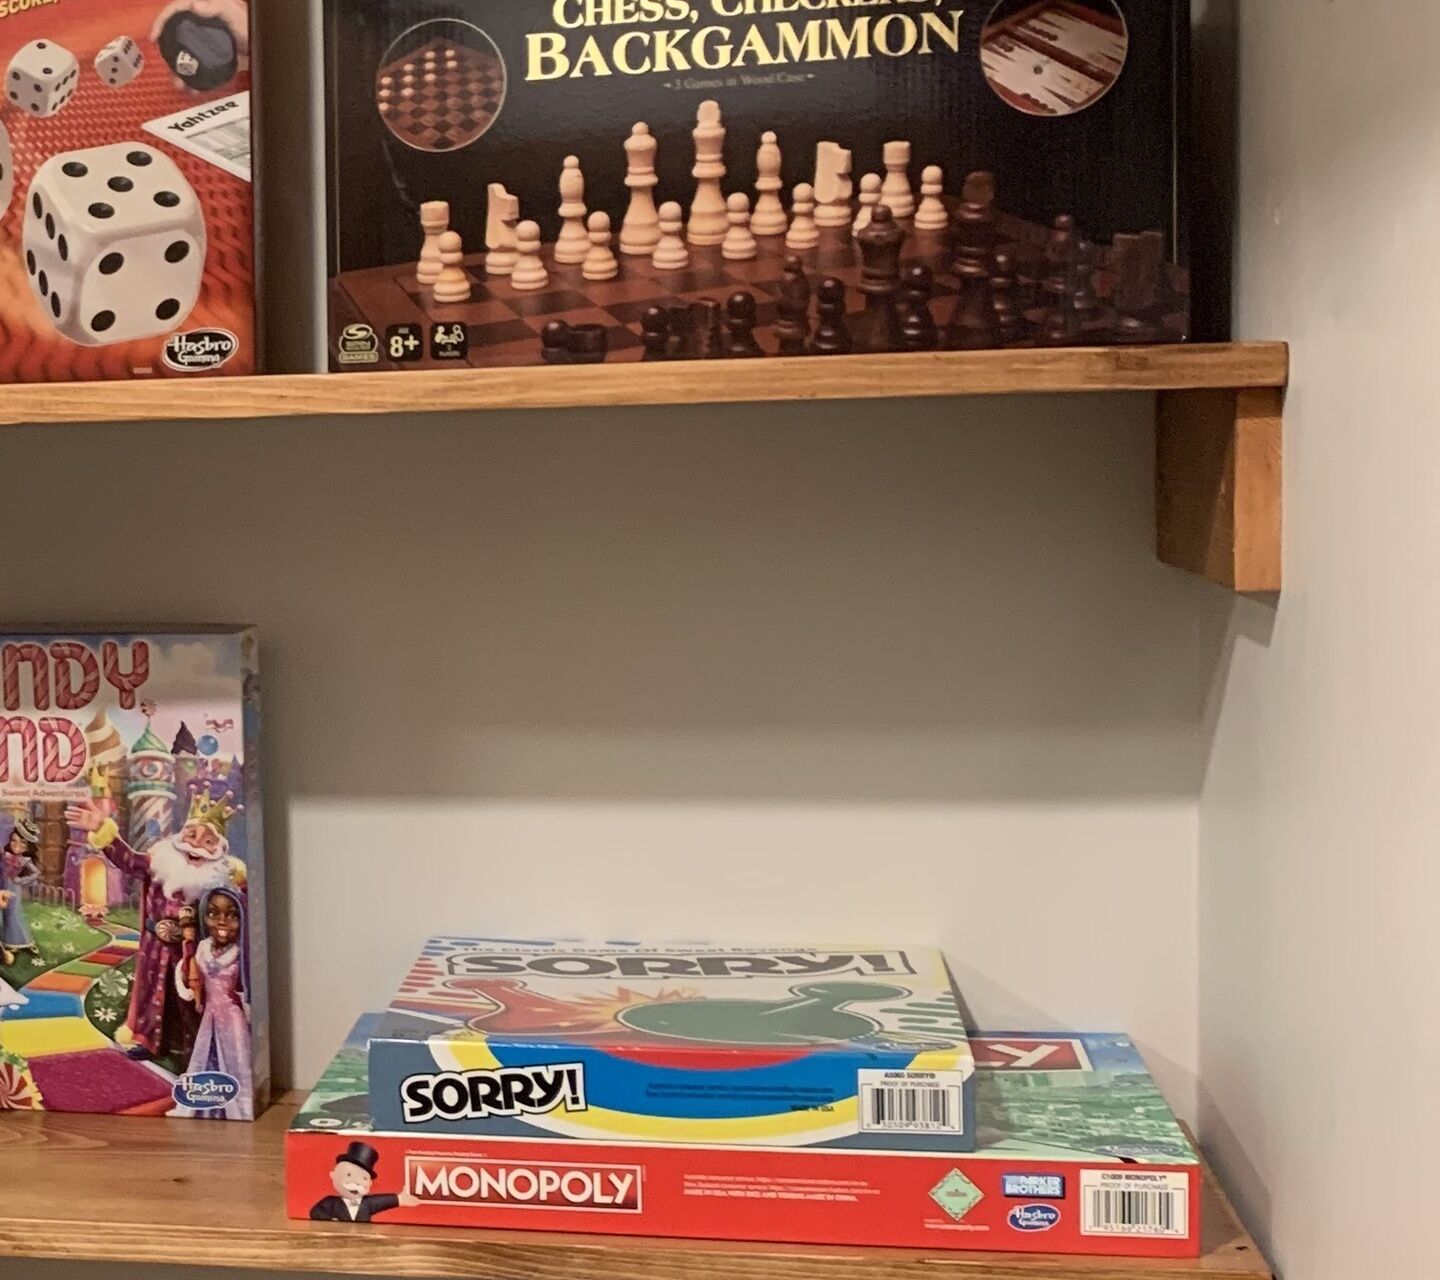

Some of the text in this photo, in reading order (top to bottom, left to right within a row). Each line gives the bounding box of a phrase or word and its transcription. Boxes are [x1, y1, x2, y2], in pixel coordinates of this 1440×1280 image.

[525, 10, 964, 81] BACKGAMMON
[675, 78, 681, 90] 3
[684, 76, 723, 89] Games
[167, 99, 239, 133] Yahtzee
[167, 335, 232, 355] Hasbro
[389, 334, 420, 358] 8+
[1, 788, 30, 797] Sweet
[461, 954, 895, 976] SORRY!
[176, 1076, 234, 1094] Hasbro
[403, 1065, 583, 1118] SORRY!
[415, 1166, 633, 1205] MONOPOLY
[1005, 1184, 1061, 1195] BROTHERS
[1021, 1175, 1061, 1186] PARKER
[1011, 1207, 1056, 1220] Hasbro
